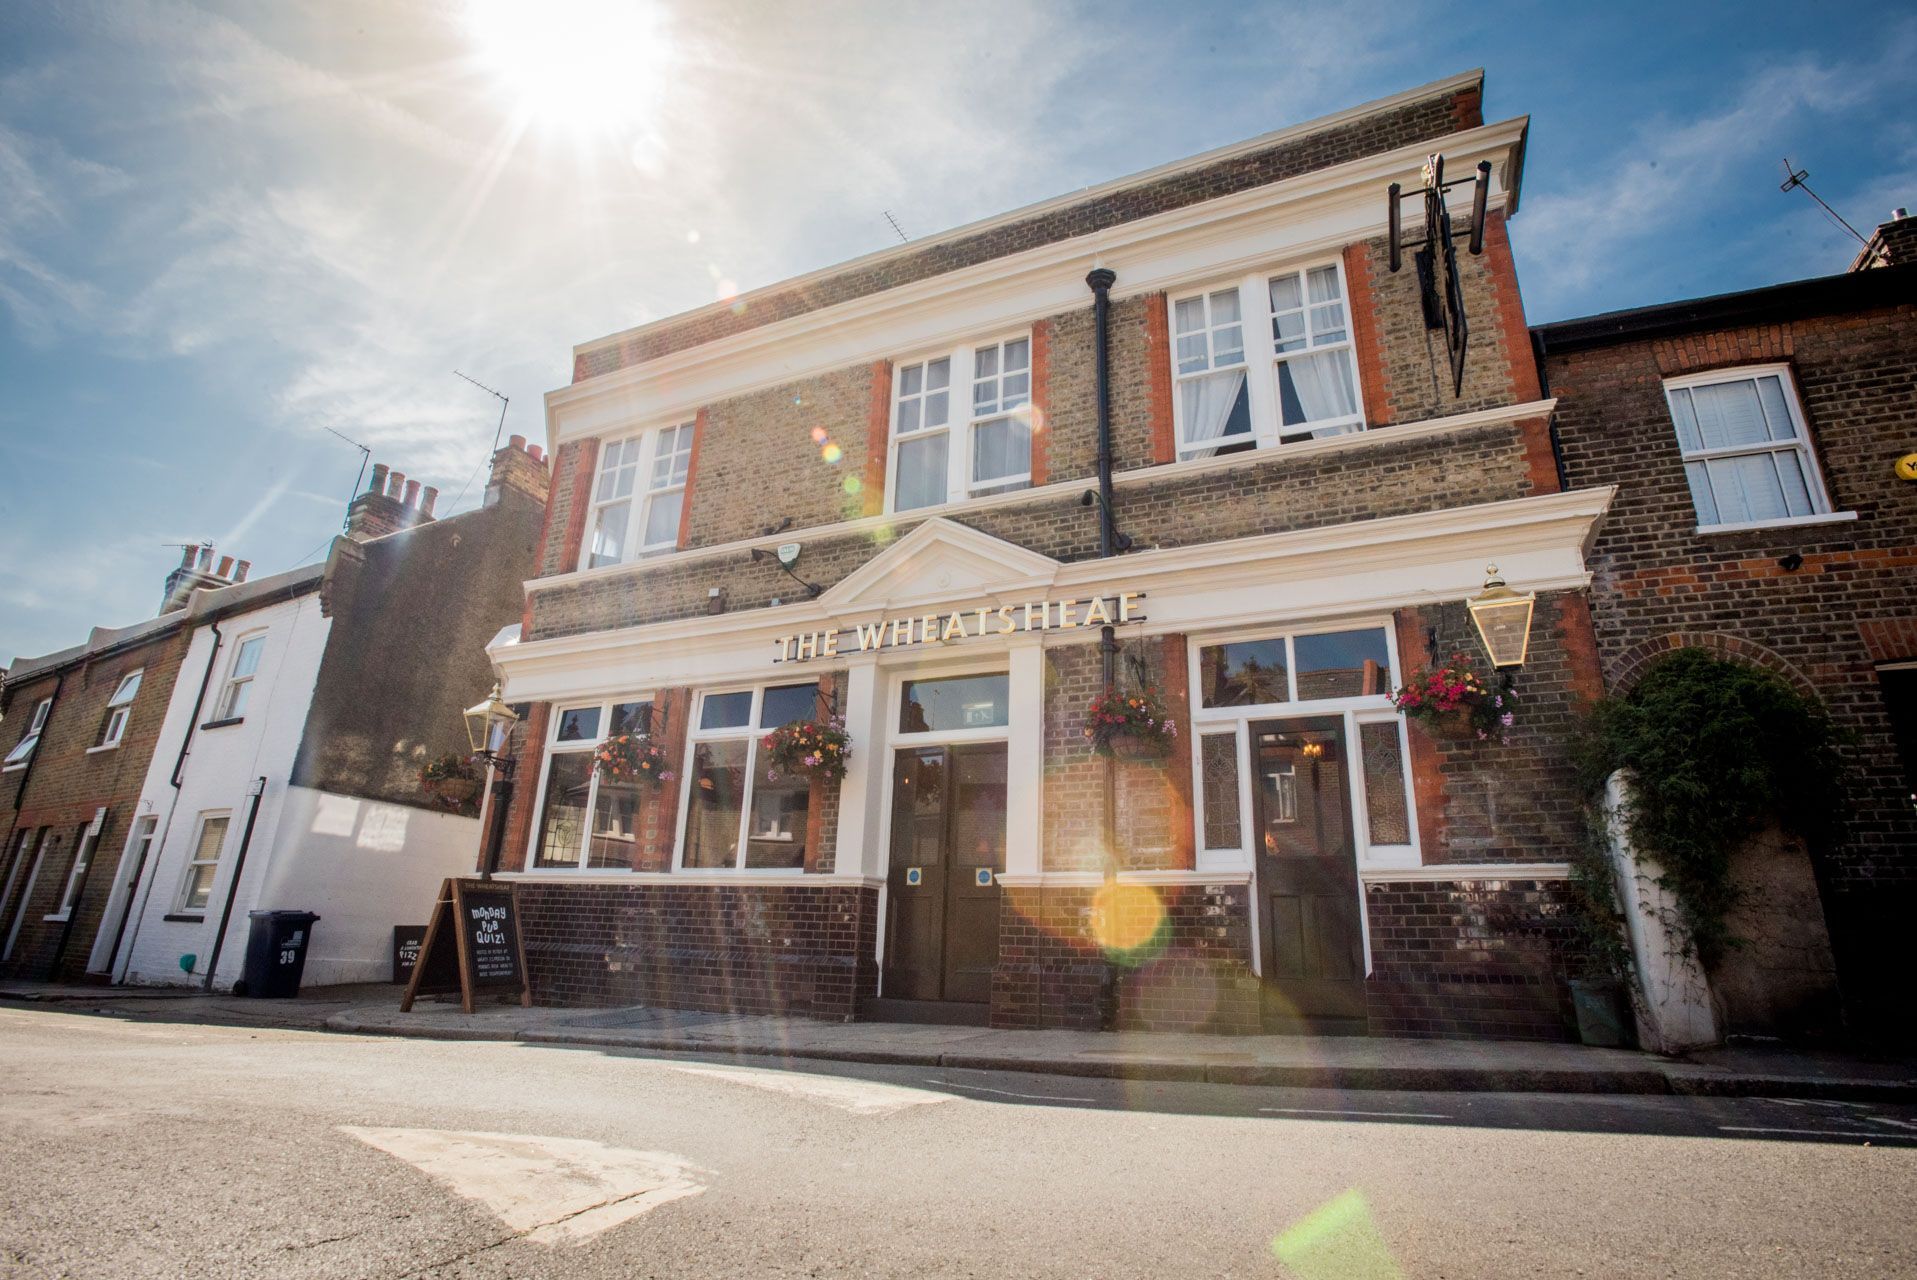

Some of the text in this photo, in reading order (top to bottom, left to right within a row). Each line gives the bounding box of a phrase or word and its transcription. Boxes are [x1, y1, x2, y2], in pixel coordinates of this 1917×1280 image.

[781, 592, 1137, 661] THE WHEATSHEAF
[481, 920, 499, 933] PUB
[476, 931, 506, 944] QUIZ!
[280, 950, 296, 965] 39
[399, 951, 417, 961] PIZZ
